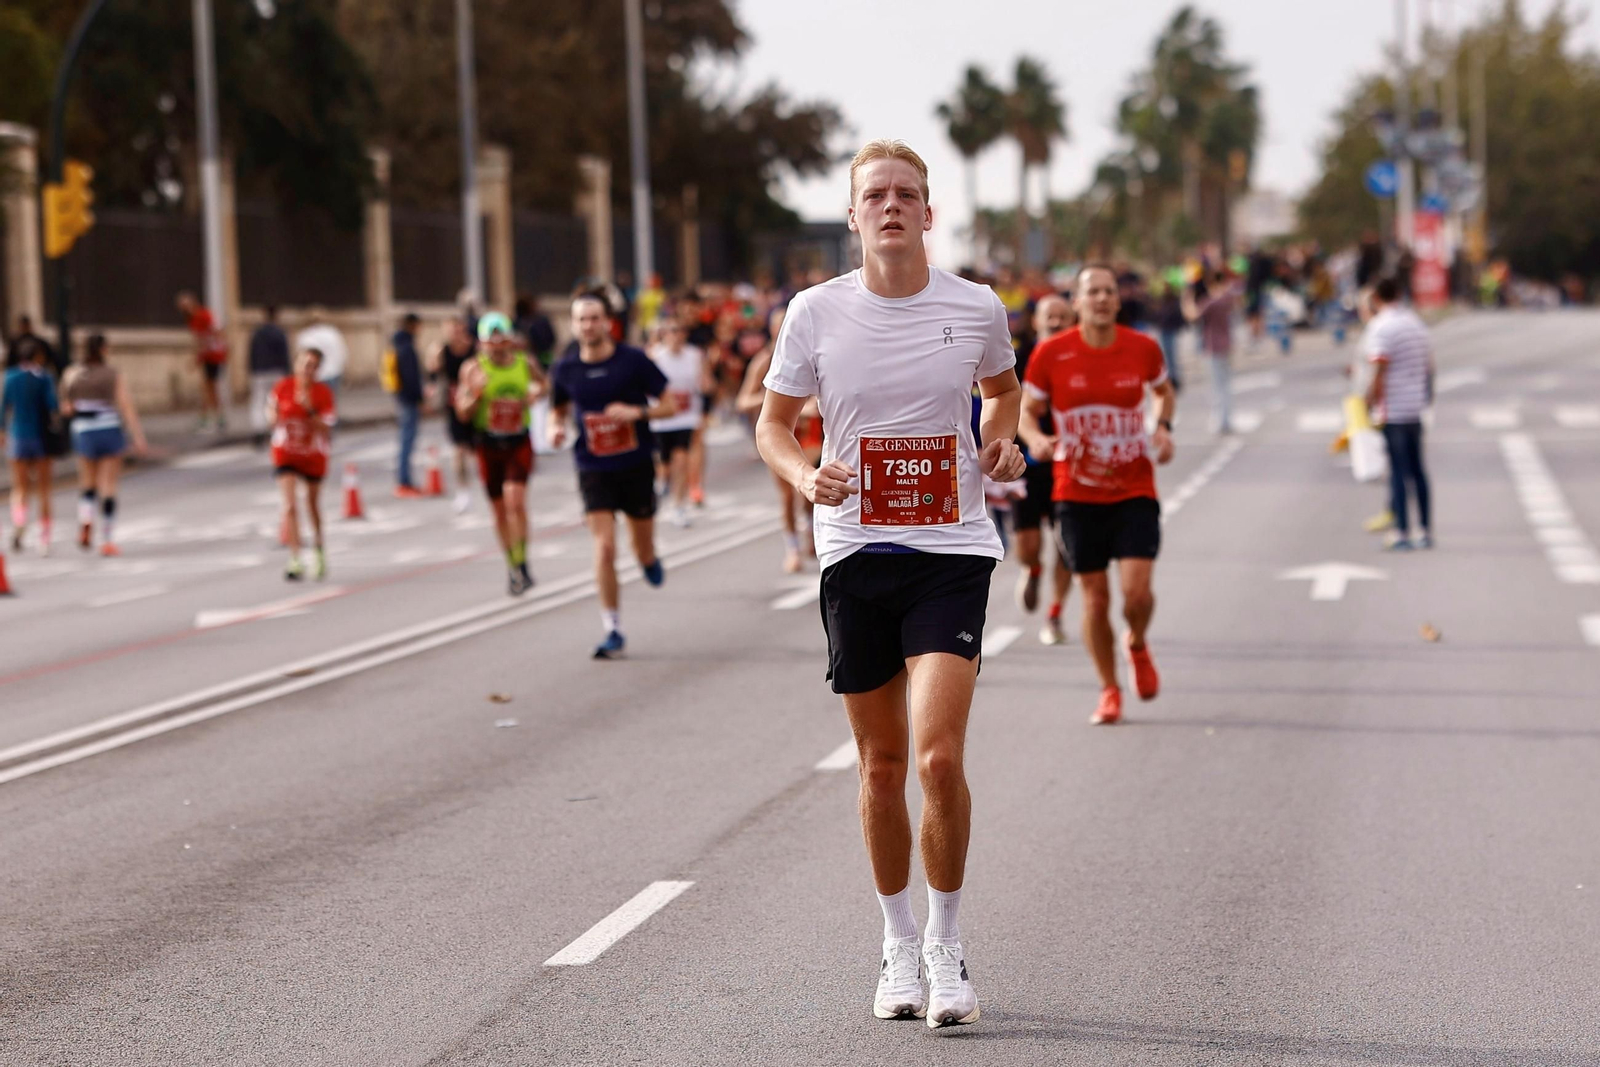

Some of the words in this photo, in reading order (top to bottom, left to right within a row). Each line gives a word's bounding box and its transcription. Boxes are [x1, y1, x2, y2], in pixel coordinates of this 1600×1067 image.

[885, 438, 945, 451] GENERALI
[882, 458, 932, 476] 7360
[888, 498, 912, 508] MÁLAGA
